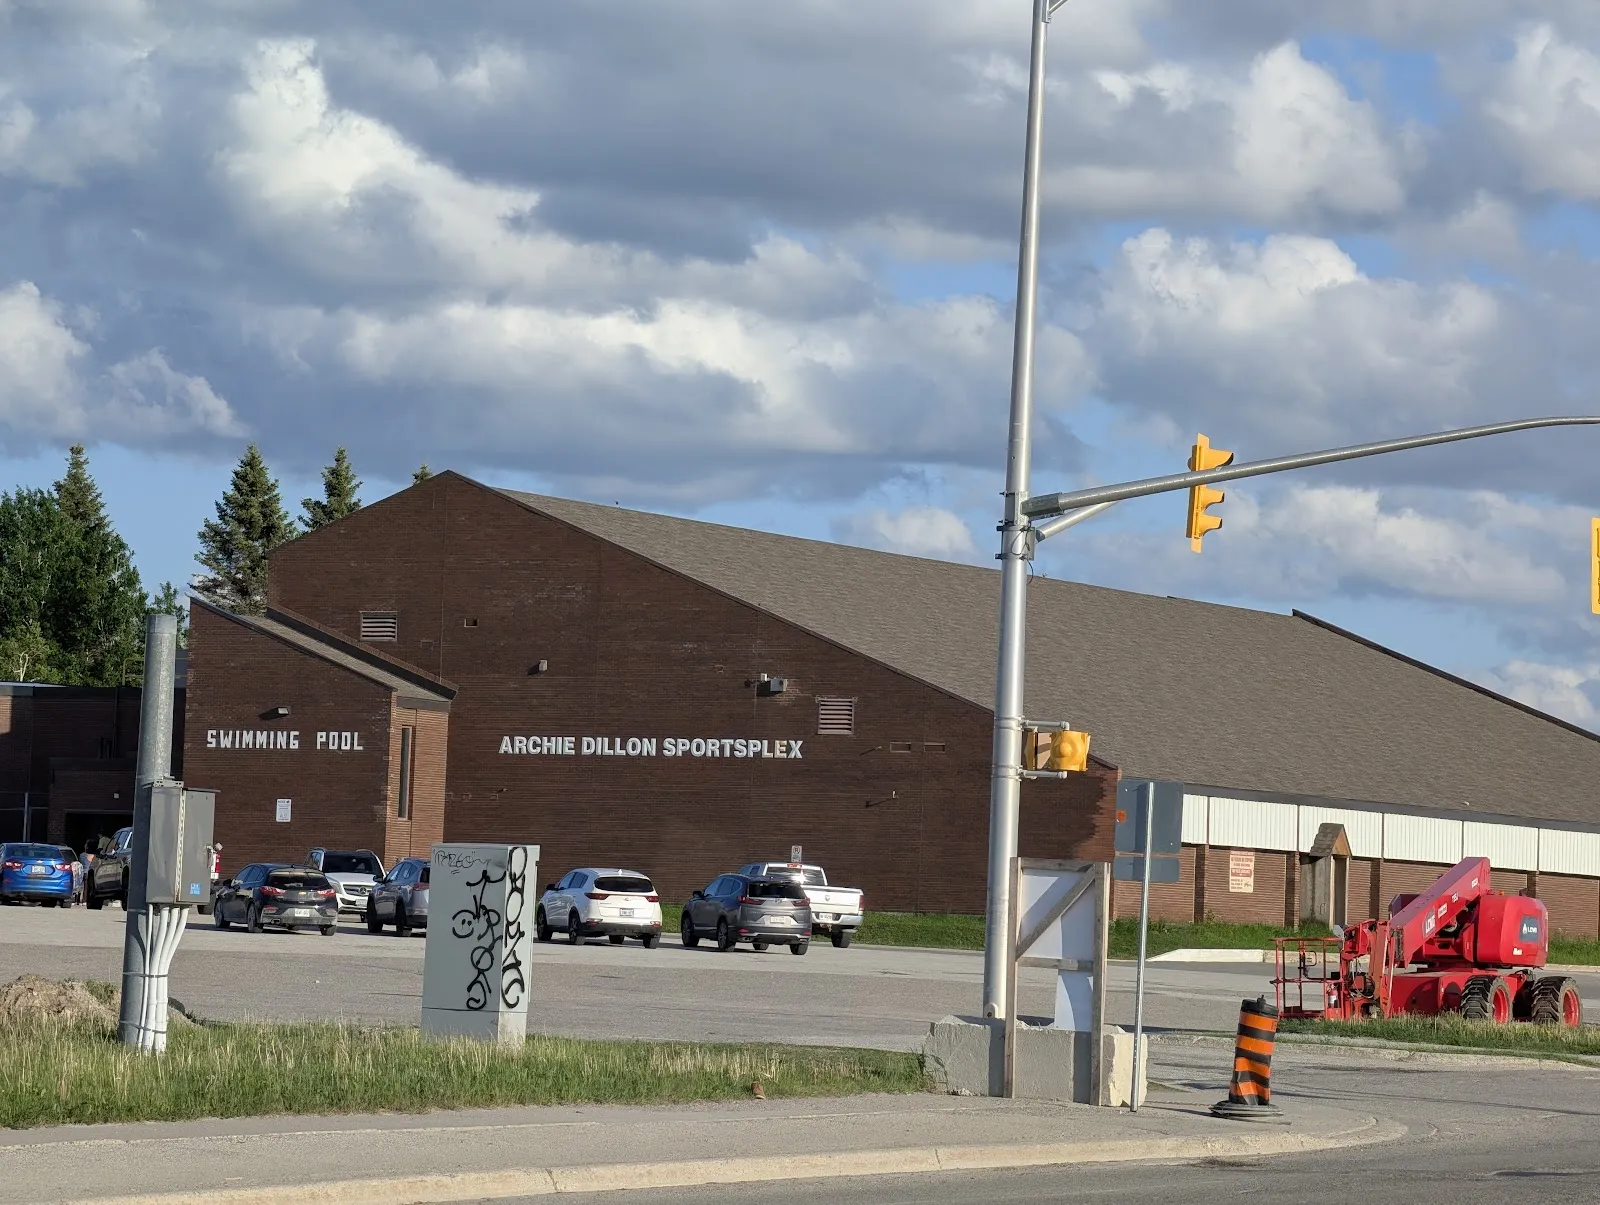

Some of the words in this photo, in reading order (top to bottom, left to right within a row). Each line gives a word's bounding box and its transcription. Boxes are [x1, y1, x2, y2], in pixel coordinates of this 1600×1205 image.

[206, 729, 300, 750] SWIMMING
[317, 731, 365, 751] POOL
[498, 735, 577, 755] ARCHIE
[580, 736, 658, 758] DILLON
[663, 737, 804, 760] SPORTSPLEX
